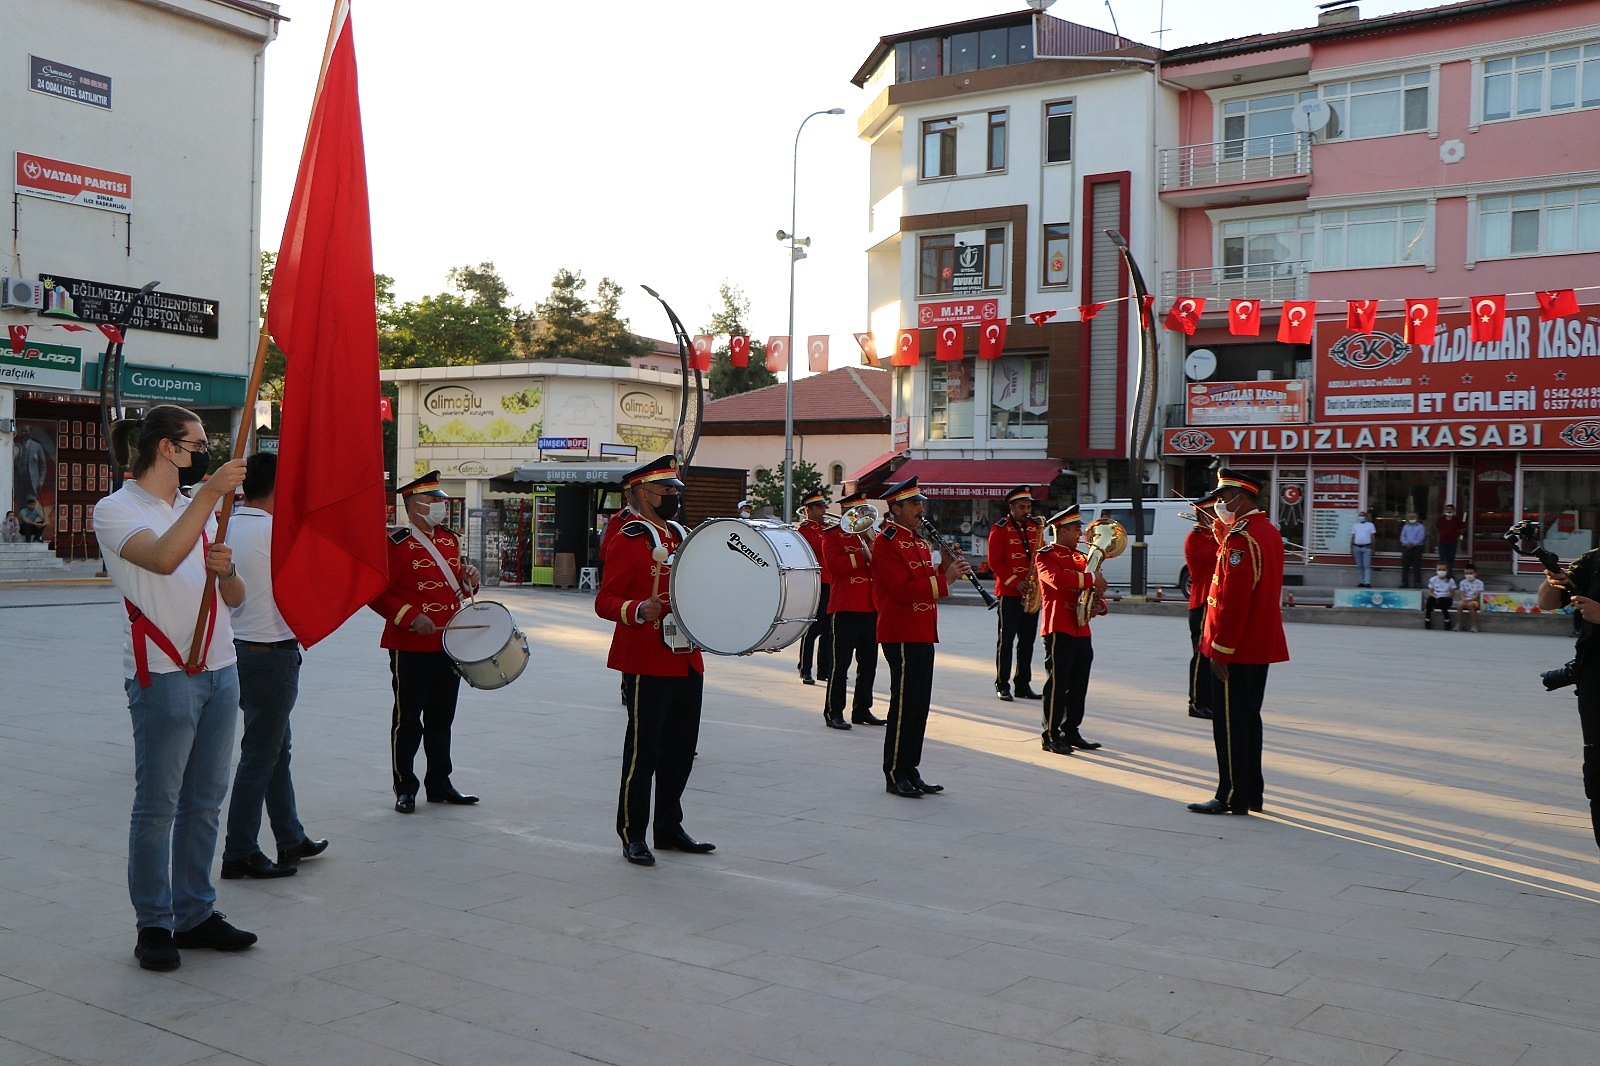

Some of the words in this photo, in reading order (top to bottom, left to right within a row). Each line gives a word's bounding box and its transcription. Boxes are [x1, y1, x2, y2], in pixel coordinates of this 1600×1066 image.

[37, 78, 45, 90] 24
[46, 81, 62, 94] ODALI
[64, 85, 78, 98] OTEL
[43, 168, 81, 185] VATAN
[953, 276, 983, 286] AVUKAT
[144, 293, 214, 316] MÜHENDİSLİK
[941, 306, 975, 317] M.H.P
[82, 309, 109, 320] Plan
[129, 318, 150, 328] roje
[160, 320, 204, 334] Taahhüt
[146, 307, 181, 322] BETON
[1538, 316, 1600, 358] KASA
[0, 367, 36, 380] rafçılık
[131, 373, 202, 392] Groupama
[430, 394, 482, 412] alimoğlu
[625, 399, 663, 418] alimoğlu
[1418, 392, 1446, 412] ET
[1453, 386, 1536, 412] GALERİ
[538, 438, 566, 450] ŞİMŞEK
[568, 438, 588, 448] BÜFE
[1228, 427, 1398, 450] YILDIZLAR
[1411, 424, 1542, 447] KASABI
[546, 470, 577, 480] ŞİMŞEK
[586, 470, 609, 480] BÜFE
[728, 532, 770, 568] Premier
